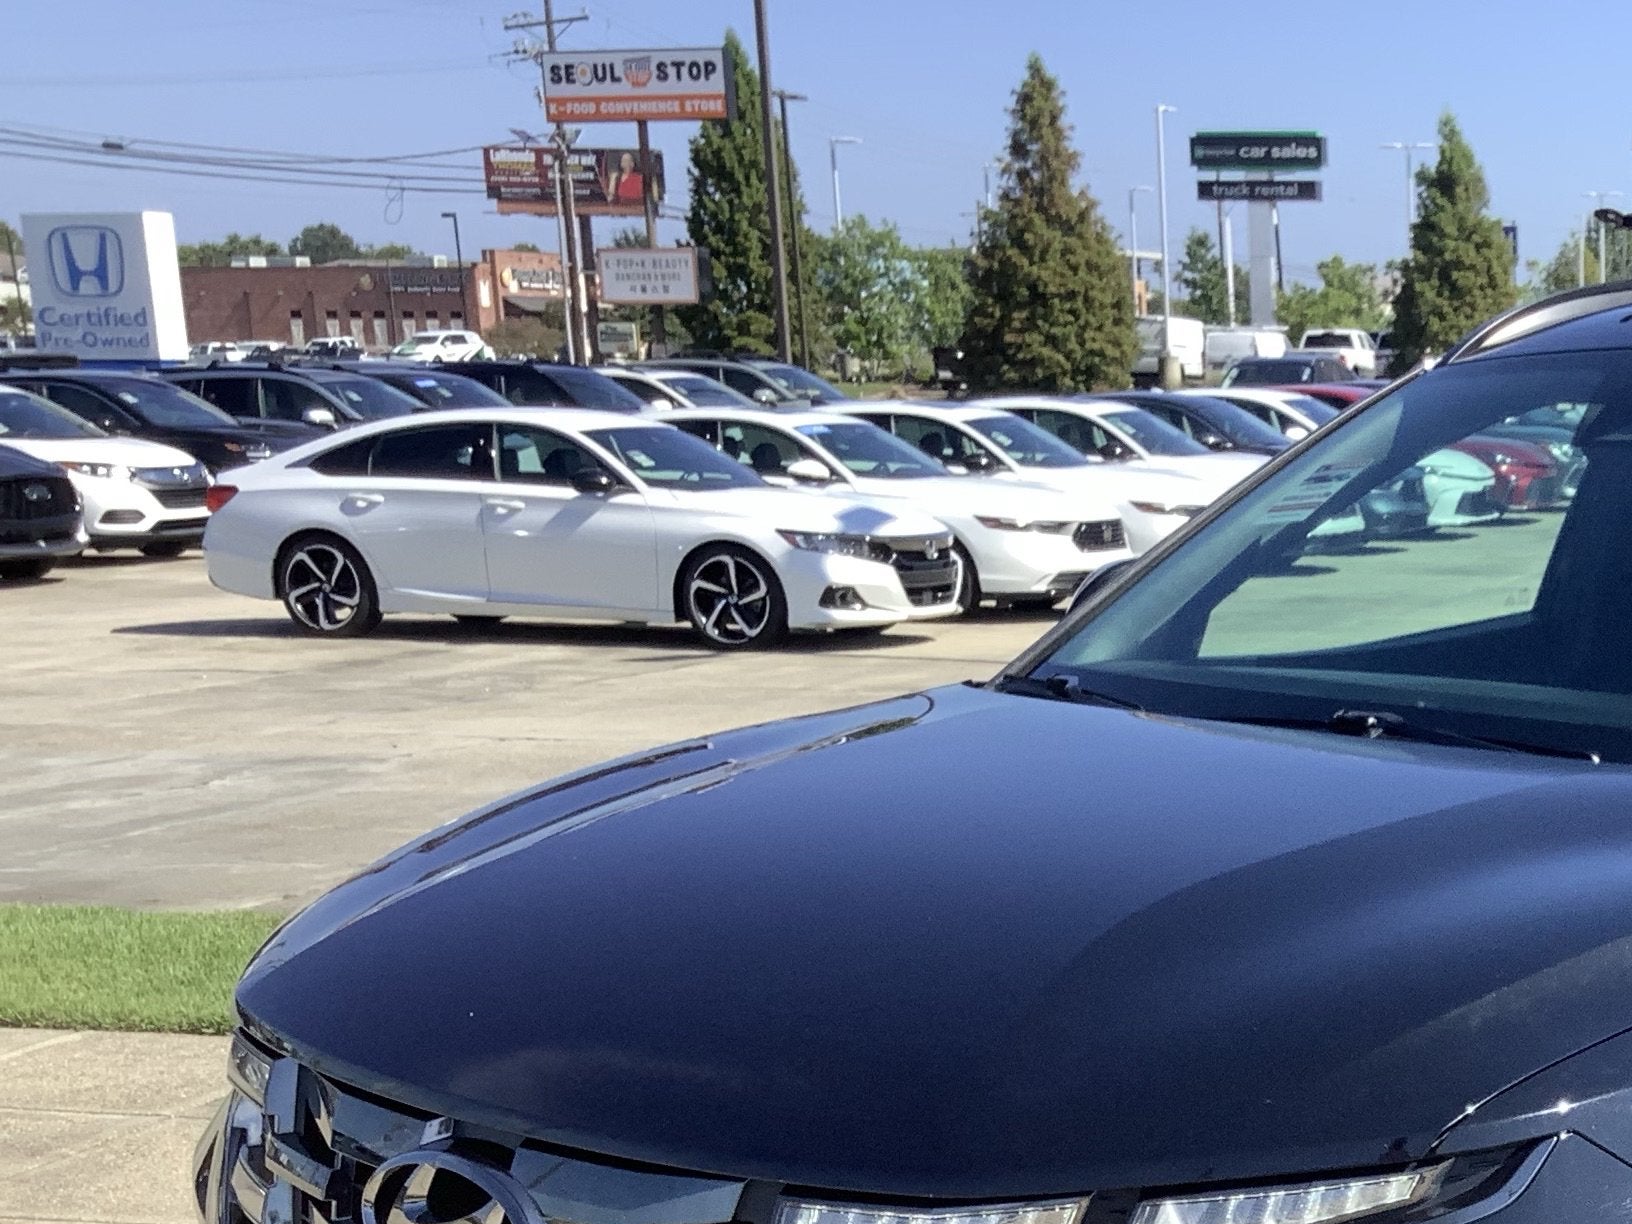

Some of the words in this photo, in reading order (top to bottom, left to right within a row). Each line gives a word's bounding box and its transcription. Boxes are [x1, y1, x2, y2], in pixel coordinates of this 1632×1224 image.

[655, 60, 718, 83] STOP
[550, 102, 596, 115] K-FOOD
[600, 101, 680, 113] CONVENIENCE
[684, 100, 723, 112] STORE
[1238, 146, 1269, 158] car
[1270, 142, 1319, 159] sales
[1212, 183, 1250, 196] truck
[1254, 183, 1299, 197] rental
[38, 305, 148, 328] Certified
[40, 331, 150, 349] Pre-Owned
